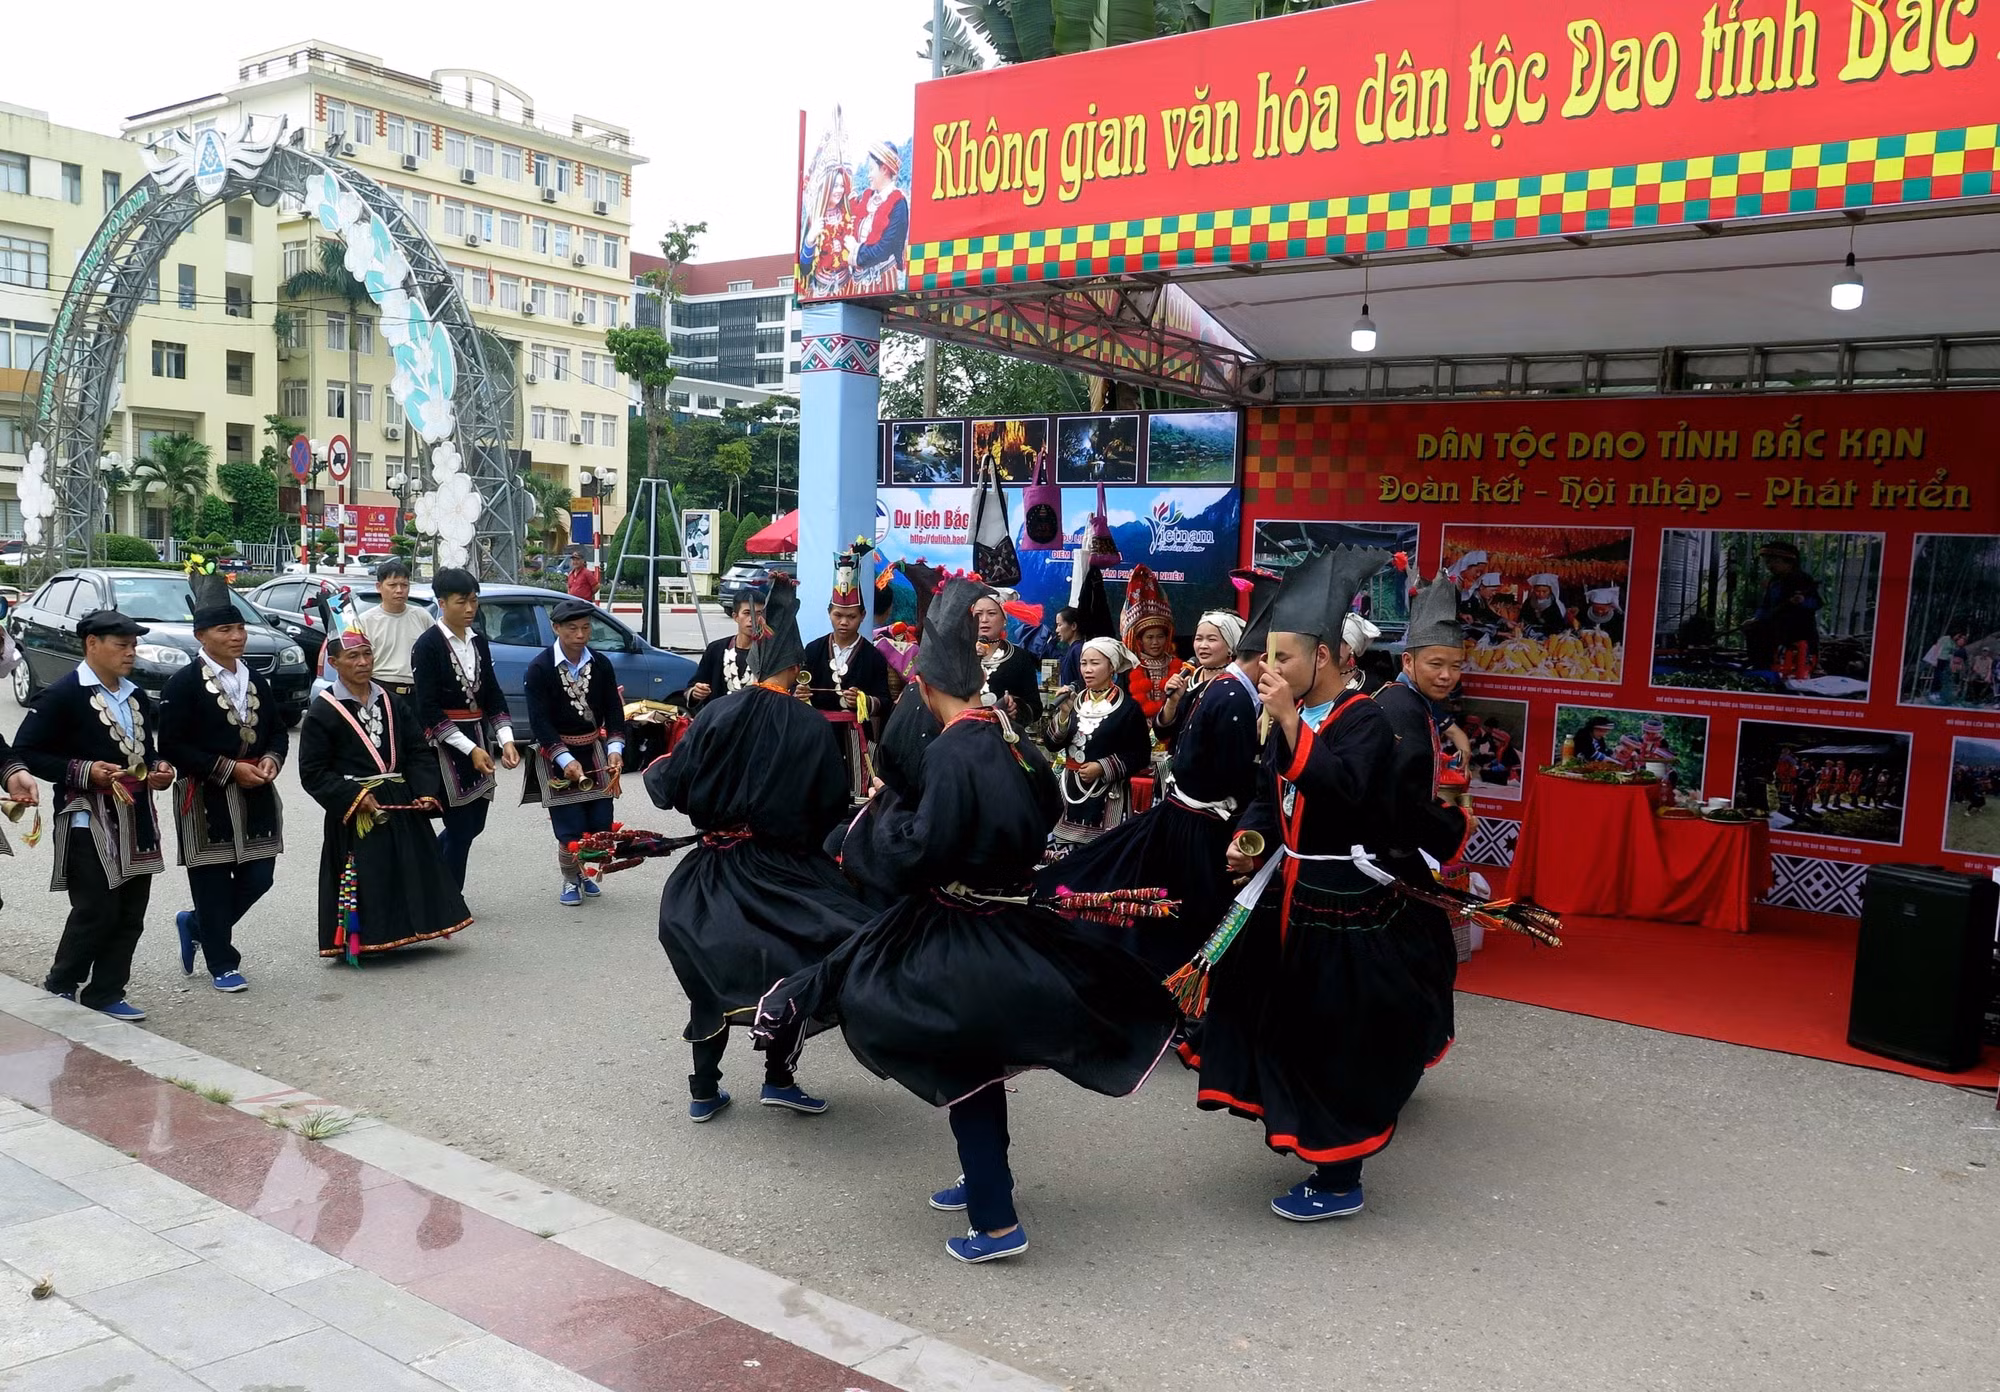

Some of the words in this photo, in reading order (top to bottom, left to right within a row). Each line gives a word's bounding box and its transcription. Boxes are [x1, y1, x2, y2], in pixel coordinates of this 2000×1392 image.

[931, 116, 1049, 206] Không
[1058, 103, 1147, 201] gian
[1160, 83, 1239, 169] văn
[1252, 66, 1339, 159] hóa
[1355, 49, 1448, 145] dân
[1463, 33, 1547, 147] tộc
[1560, 18, 1679, 118] Dao
[1695, 0, 1818, 100] tỉnh
[1417, 426, 1483, 459] DÂN
[1493, 425, 1556, 467] TỘC
[1567, 431, 1645, 459] DAO
[1658, 420, 1738, 458] TỈNH
[1751, 415, 1825, 458] BẮC
[1838, 427, 1924, 466] KẠN
[1378, 475, 1460, 502] Đoàn
[1470, 472, 1525, 503] kết
[1558, 476, 1616, 509] Hội
[1627, 475, 1722, 512] nhập
[1763, 477, 1858, 507] Phát
[1869, 467, 1970, 508] triển
[894, 509, 911, 529] Du
[915, 509, 941, 533] lịch
[943, 506, 970, 530] Bắc
[1144, 516, 1215, 555] Vietnam
